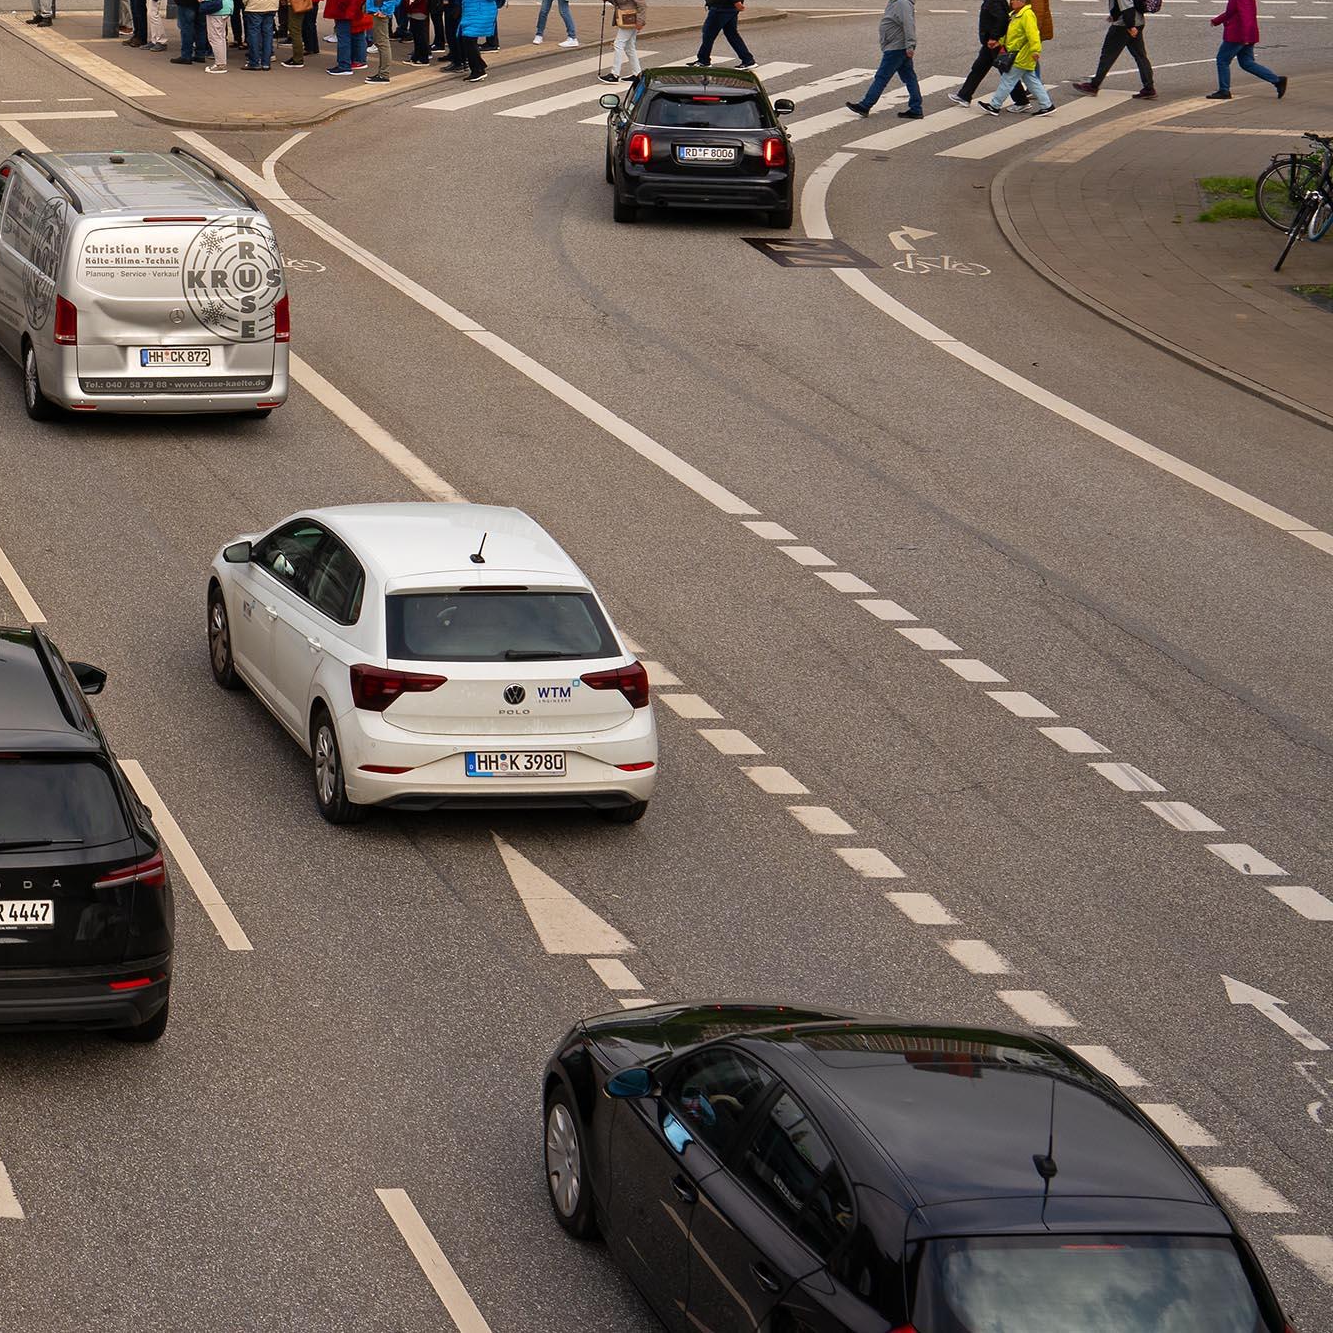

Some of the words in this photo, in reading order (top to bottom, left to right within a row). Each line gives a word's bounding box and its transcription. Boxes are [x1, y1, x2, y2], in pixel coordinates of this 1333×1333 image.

[685, 148, 698, 157] RD
[703, 148, 709, 157] F
[710, 148, 734, 158] 8006
[84, 244, 141, 254] Christian
[144, 244, 180, 254] Kruse
[85, 256, 180, 265] Kälte-Klima-Technik
[85, 270, 116, 279] Planung
[120, 270, 148, 278] Service
[151, 270, 180, 278] Verkauf
[148, 351, 164, 363] HH
[170, 351, 186, 363] CK
[187, 350, 209, 363] 872
[84, 380, 105, 389] Tel.:
[105, 380, 123, 389] 040
[142, 380, 155, 389] 79
[174, 379, 267, 389] www.kruse-kaelte.de
[537, 686, 572, 698] WTM
[477, 754, 499, 770] HH
[509, 754, 521, 770] K
[523, 754, 564, 770] 3980
[8, 903, 50, 922] 4447
